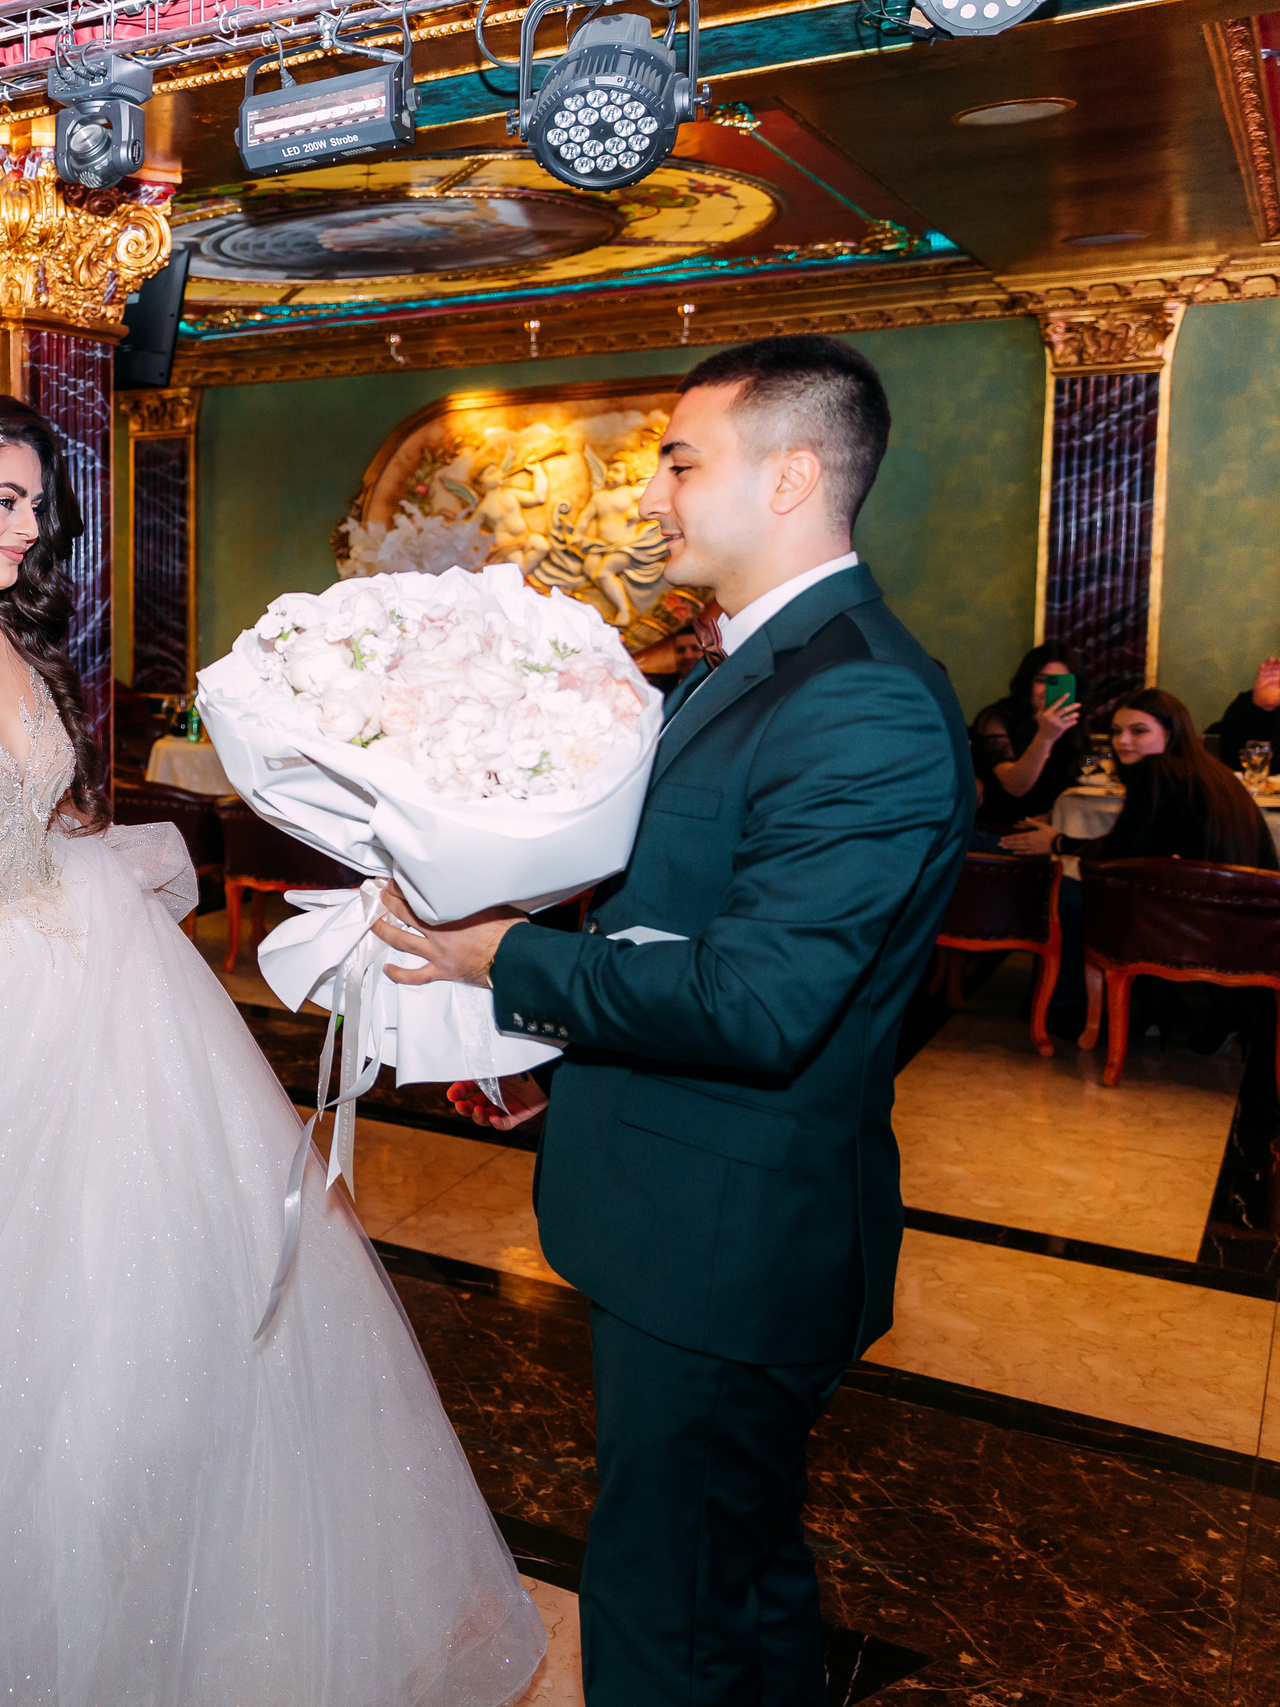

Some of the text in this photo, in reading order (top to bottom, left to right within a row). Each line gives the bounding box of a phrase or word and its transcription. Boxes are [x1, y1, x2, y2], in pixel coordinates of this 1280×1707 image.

[281, 134, 359, 158] LED 200W Strobe
